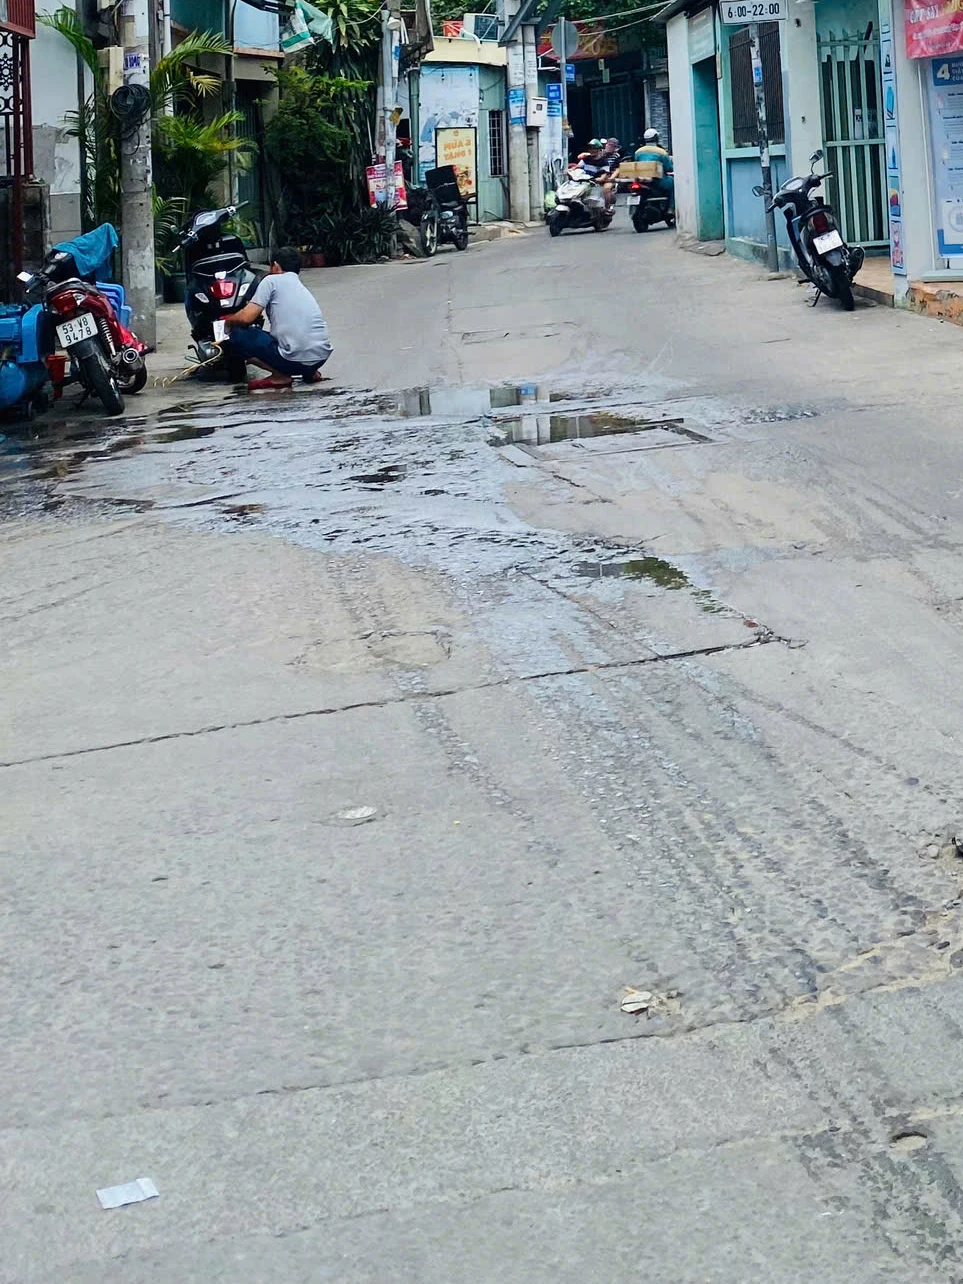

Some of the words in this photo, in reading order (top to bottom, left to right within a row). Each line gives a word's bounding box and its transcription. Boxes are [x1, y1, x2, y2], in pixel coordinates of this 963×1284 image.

[728, 3, 780, 18] 6:00-22:00
[936, 63, 951, 80] 4
[65, 326, 92, 344] 9478
